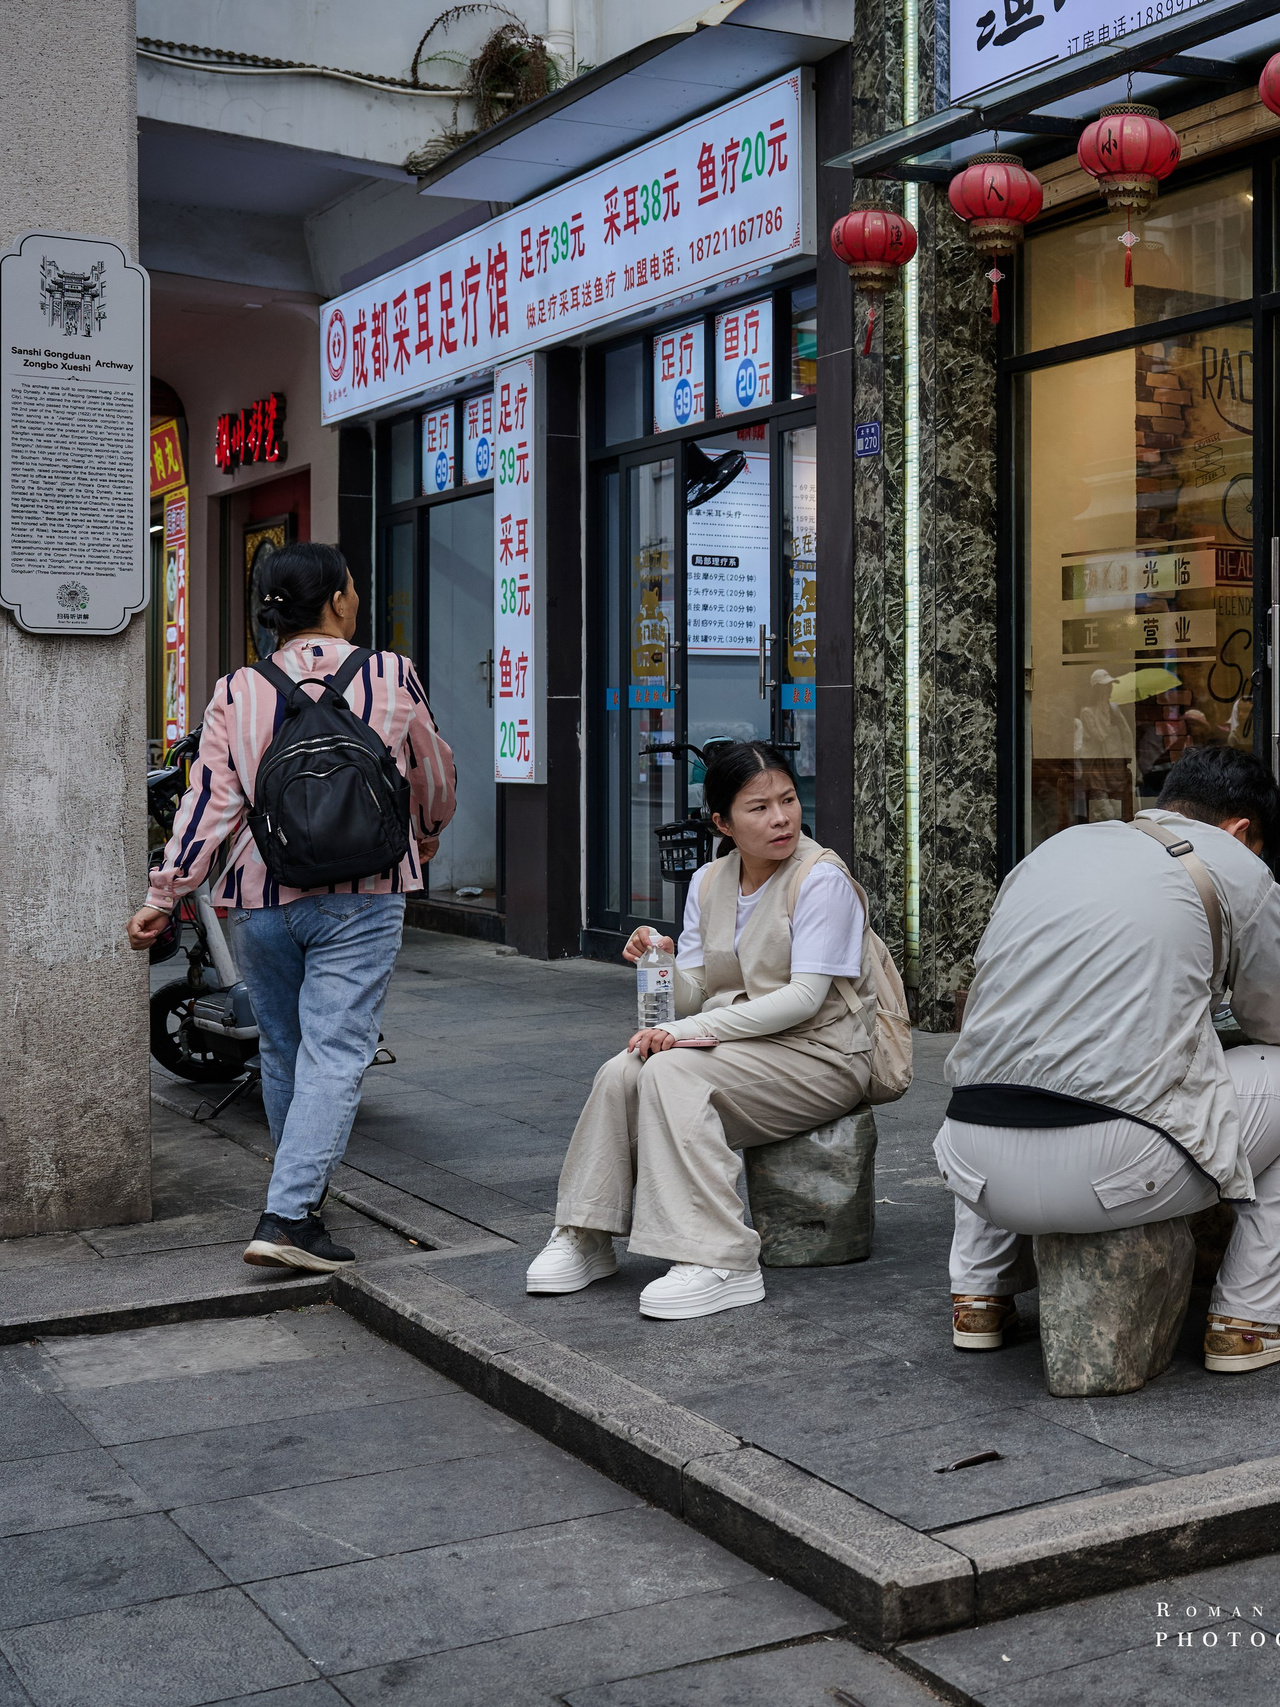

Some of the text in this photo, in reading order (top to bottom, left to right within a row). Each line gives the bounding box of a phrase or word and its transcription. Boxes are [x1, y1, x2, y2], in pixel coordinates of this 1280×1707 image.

[697, 118, 789, 207] 鱼疗20元
[1101, 128, 1117, 156] 小
[603, 168, 681, 245] 采耳38元
[987, 175, 1004, 202] 人
[519, 212, 586, 283] 足疗39元
[689, 206, 783, 265] 18721167786
[351, 241, 509, 390] 成都采耳足疗馆
[526, 270, 617, 331] 做足疗采耳送鱼疗
[11, 346, 91, 361] Sanshi Gongduan
[724, 308, 760, 361] 鱼疗
[23, 359, 91, 372] Zongbo Xueshi
[95, 359, 134, 372] Archway
[660, 332, 694, 383] 足疗
[737, 361, 770, 399] 20元
[498, 382, 529, 436] 足疗
[674, 380, 704, 416] 39元
[427, 412, 449, 453] 足疗
[864, 436, 878, 450] 270
[150, 435, 179, 486] 肉丸
[499, 441, 531, 487] 39元
[499, 513, 530, 567] 采耳
[790, 532, 817, 560] 正在
[500, 573, 531, 618] 38元
[1084, 616, 1191, 649] 正营业
[498, 645, 529, 700] 鱼疗
[500, 719, 531, 763] 20元
